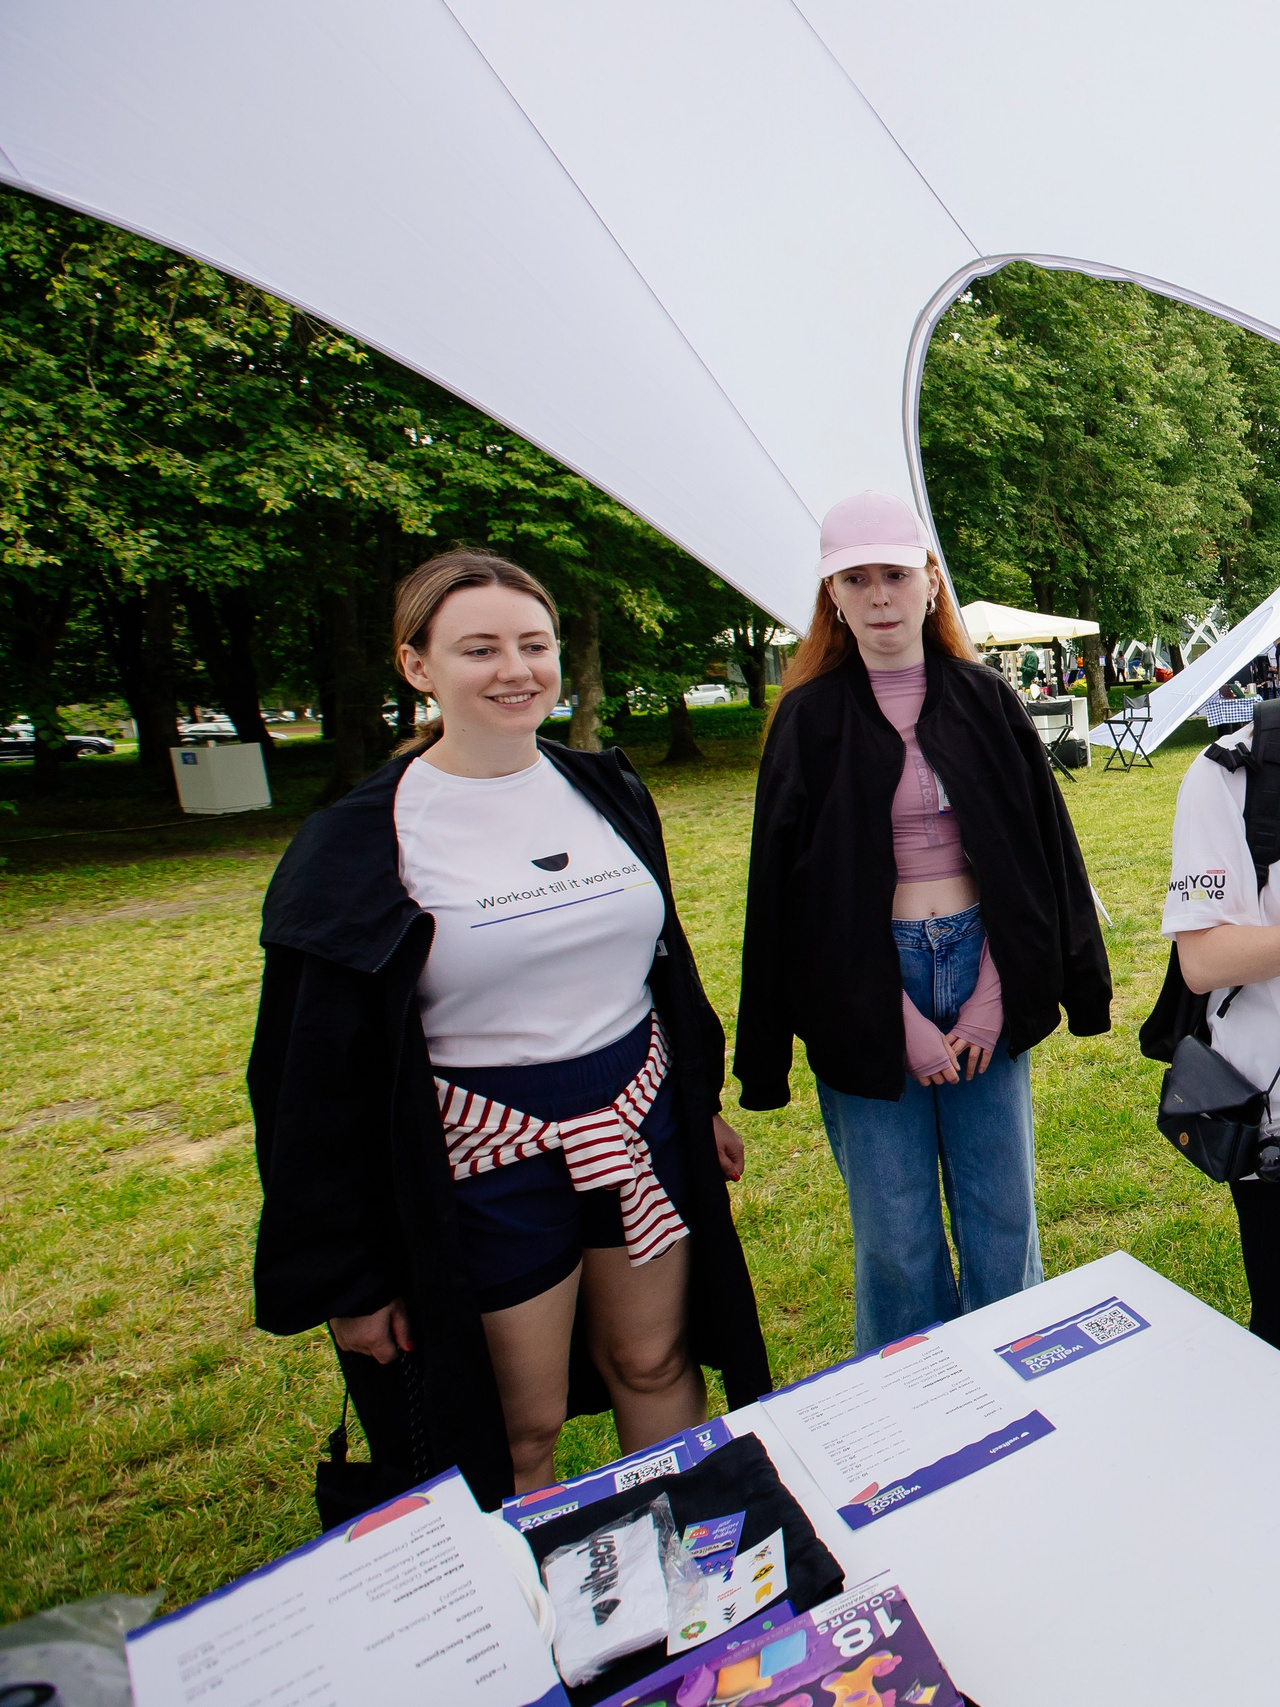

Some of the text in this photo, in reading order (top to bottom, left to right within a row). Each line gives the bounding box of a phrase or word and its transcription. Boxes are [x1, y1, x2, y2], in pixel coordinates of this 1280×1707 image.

[476, 862, 640, 909] Workout till it works out
[989, 1436, 1020, 1454] welltech
[815, 1589, 896, 1635] COLORS
[830, 1608, 902, 1659] 18
